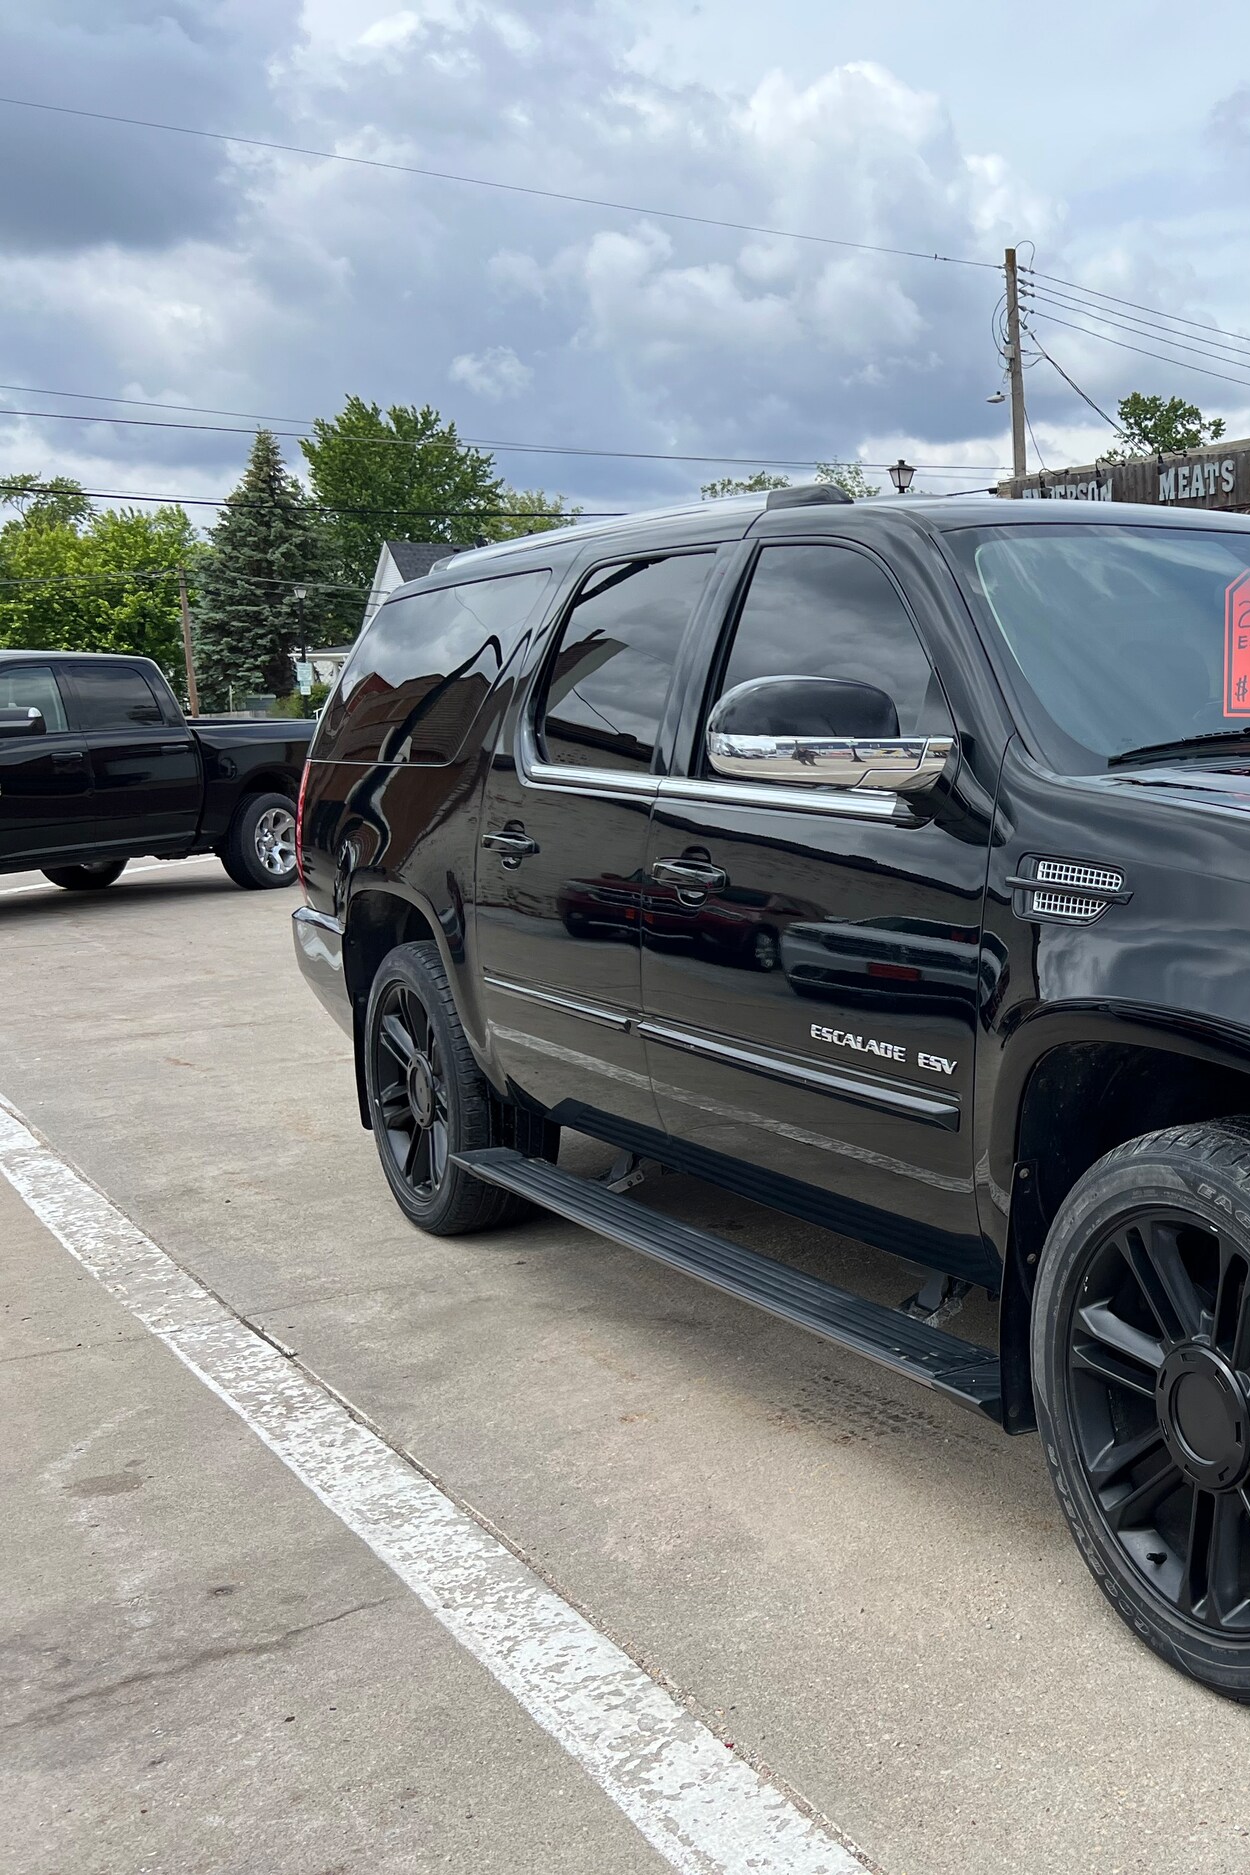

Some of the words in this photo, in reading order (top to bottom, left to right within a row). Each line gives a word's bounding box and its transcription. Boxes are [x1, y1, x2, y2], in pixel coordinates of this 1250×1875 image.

[1158, 459, 1236, 501] MEATS
[810, 1023, 907, 1063] ESCALADE
[917, 1052, 958, 1075] ESV
